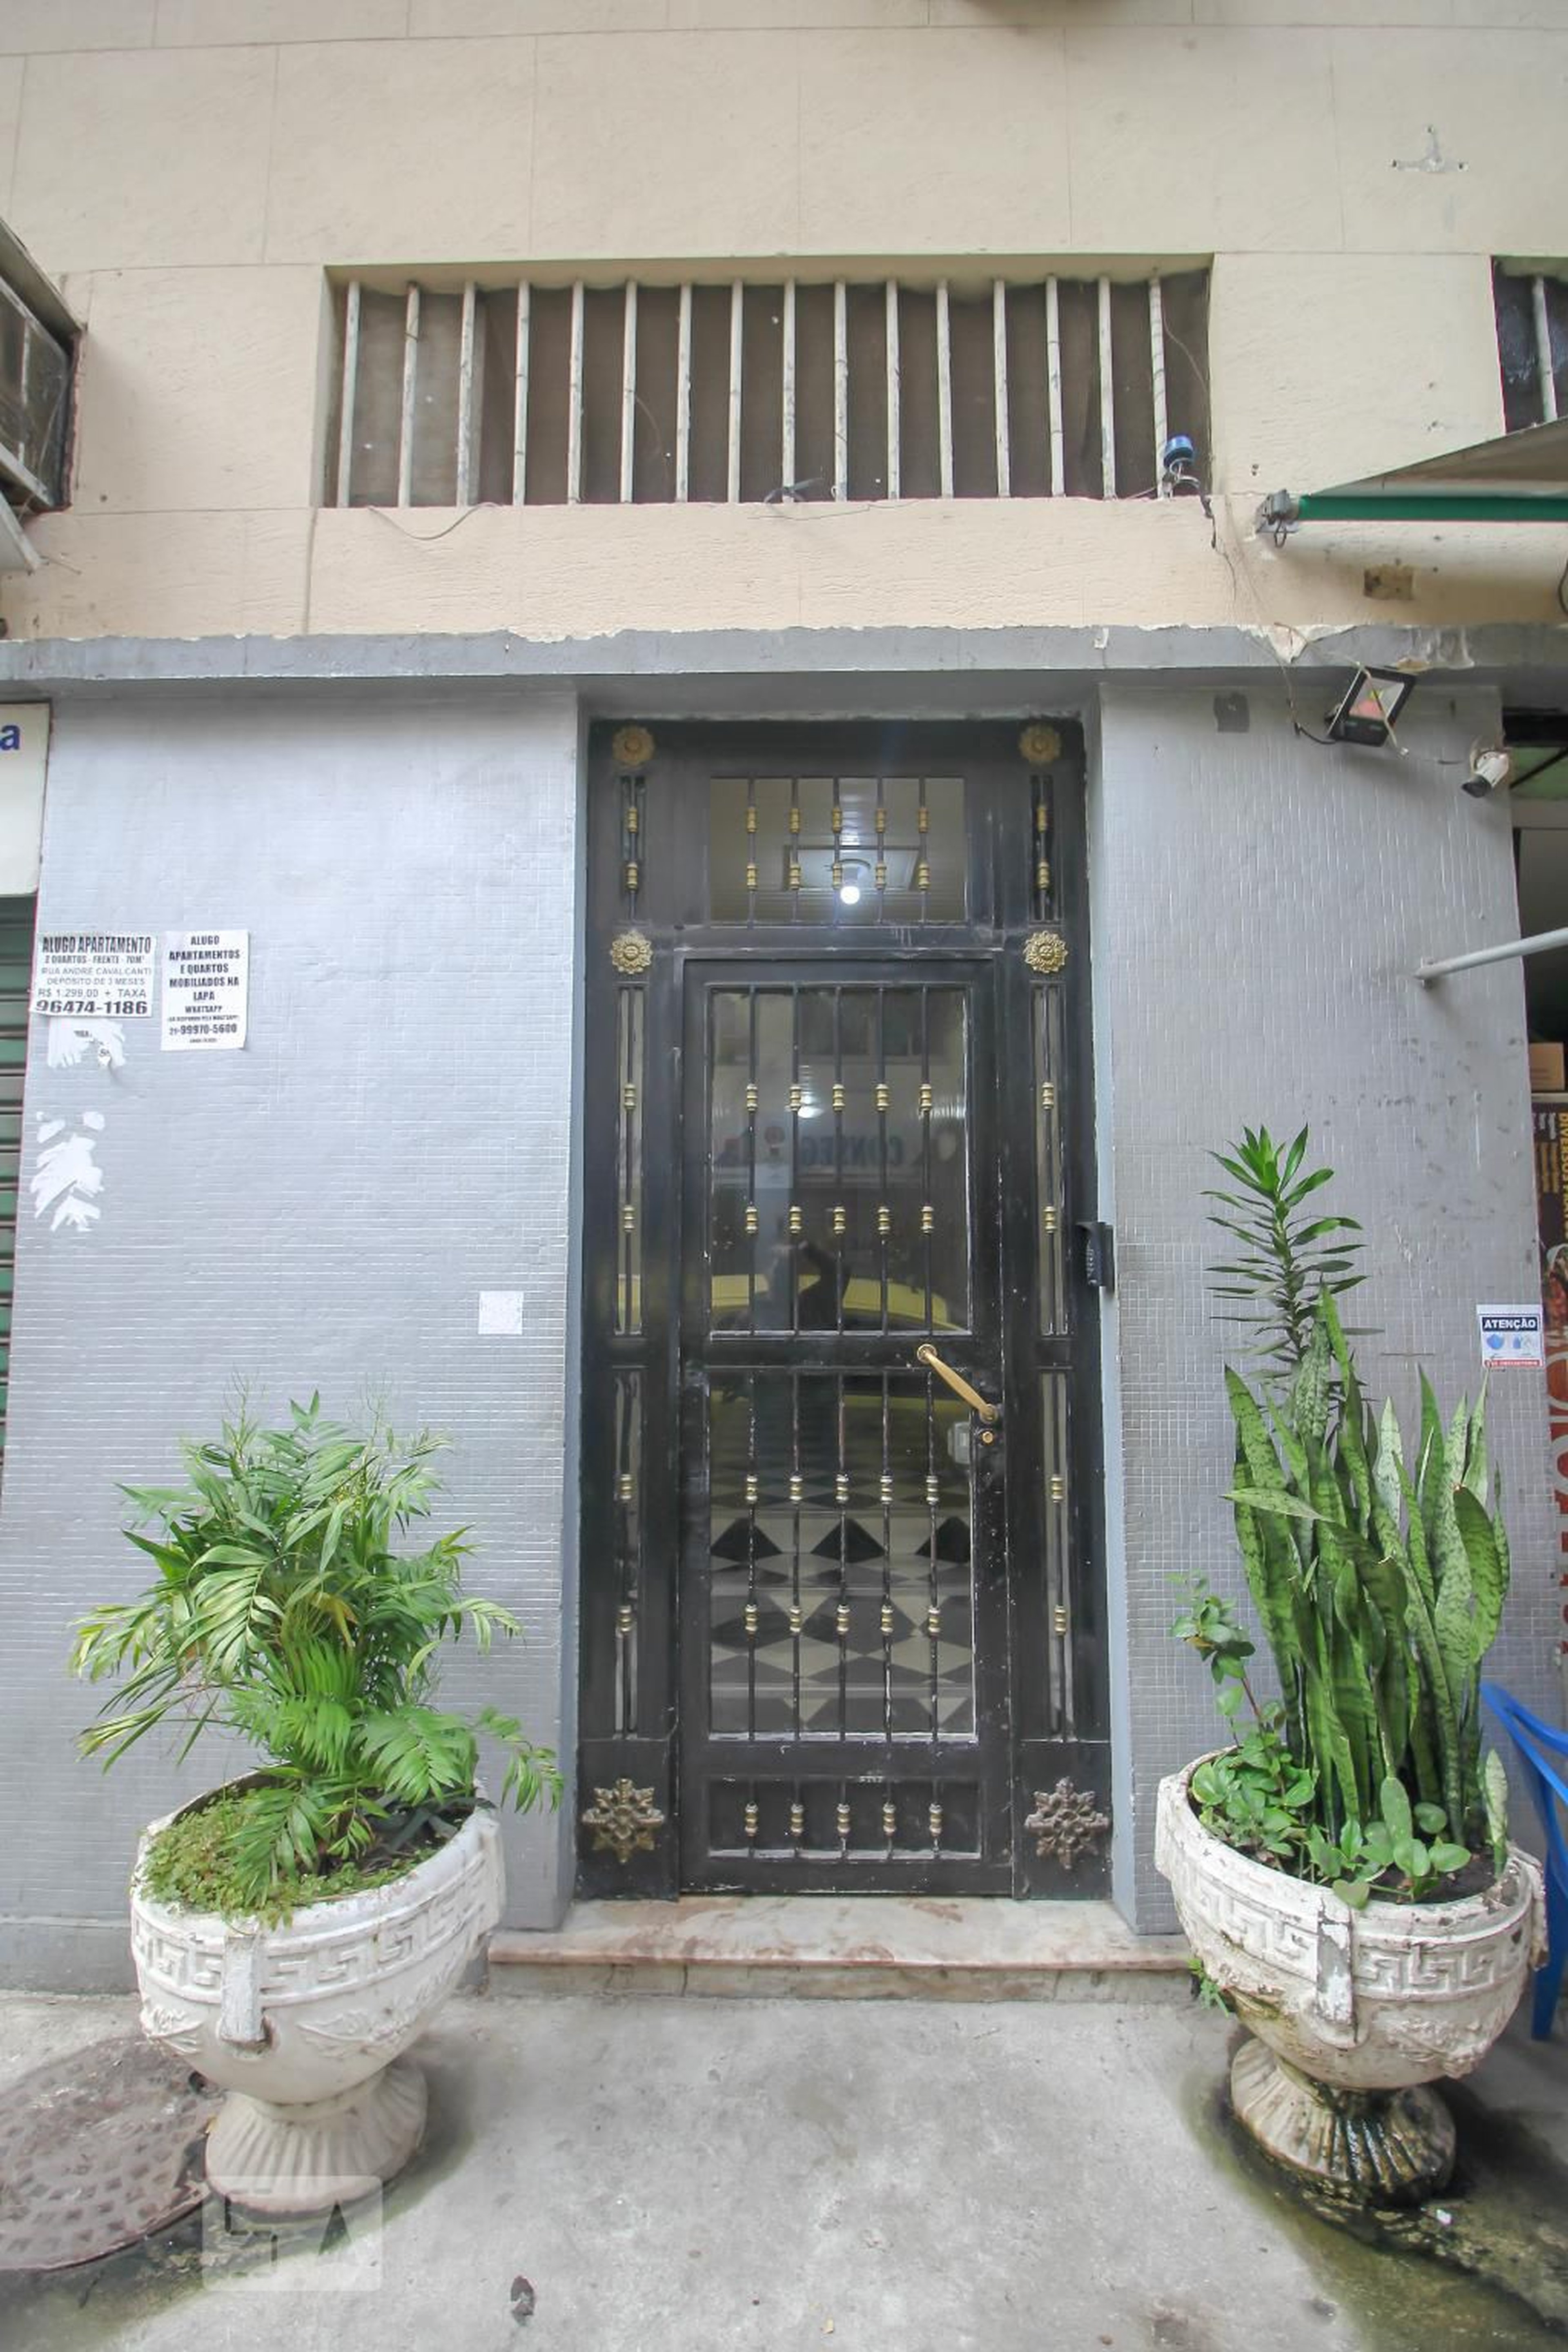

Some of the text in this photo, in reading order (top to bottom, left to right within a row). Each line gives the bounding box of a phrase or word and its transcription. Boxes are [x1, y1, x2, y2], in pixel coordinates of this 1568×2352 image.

[42, 936, 151, 953] ALUGO APARTAMENTO
[191, 935, 220, 945] ALUGO
[51, 955, 87, 964] QUARTOS
[93, 955, 119, 964] FRENTE
[169, 949, 240, 960] APARTAMENTOS
[180, 963, 229, 975] E QUARTOS
[169, 976, 239, 988] MOBILIADOS NA
[38, 989, 51, 998] R$
[118, 989, 146, 998] TAXA
[194, 991, 215, 1001] LAPA
[36, 1000, 148, 1014] 96474-1186
[1484, 1318, 1536, 1330] ATENÇÃO
